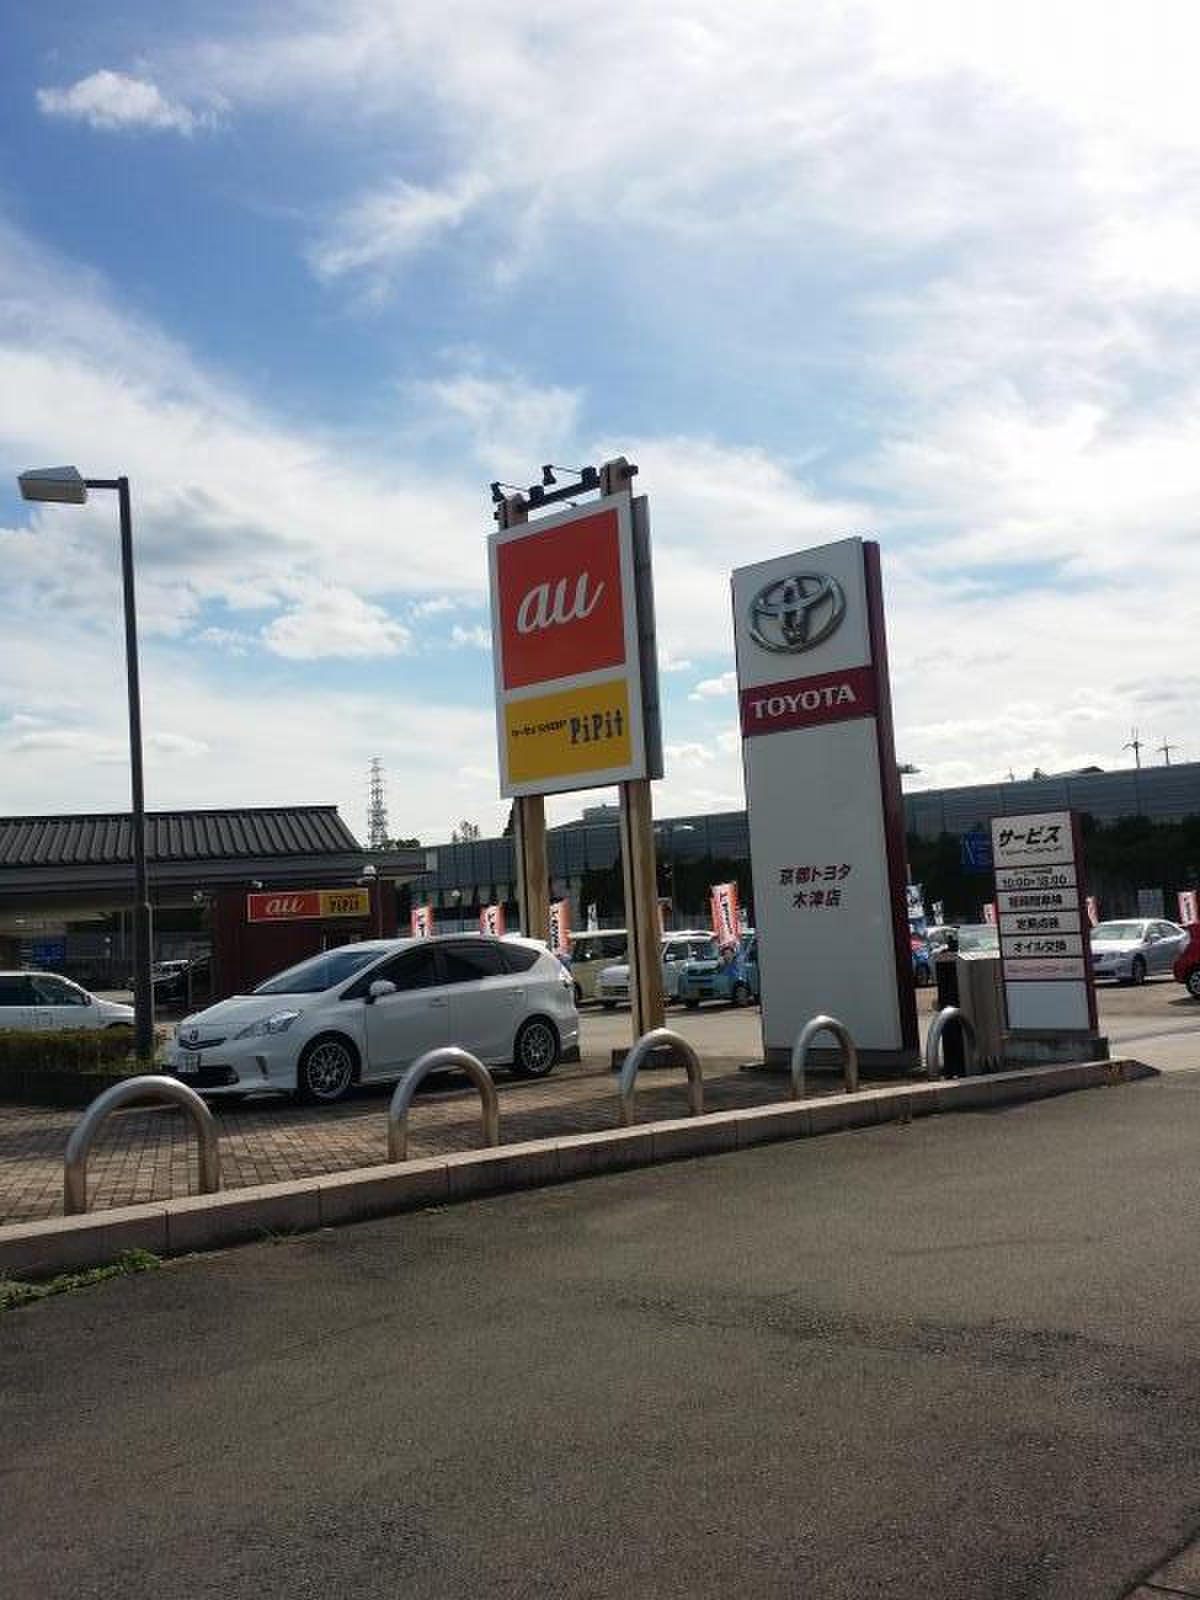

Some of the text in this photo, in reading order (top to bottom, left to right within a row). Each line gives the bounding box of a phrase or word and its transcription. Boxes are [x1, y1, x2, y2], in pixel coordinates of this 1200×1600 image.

[516, 571, 605, 634] au
[751, 684, 856, 719] TOYOTA
[569, 708, 623, 745] PiPit
[999, 825, 1062, 847] サービス
[779, 864, 851, 886] 京都トヨタ
[265, 895, 305, 913] au
[792, 890, 841, 909] 木津店
